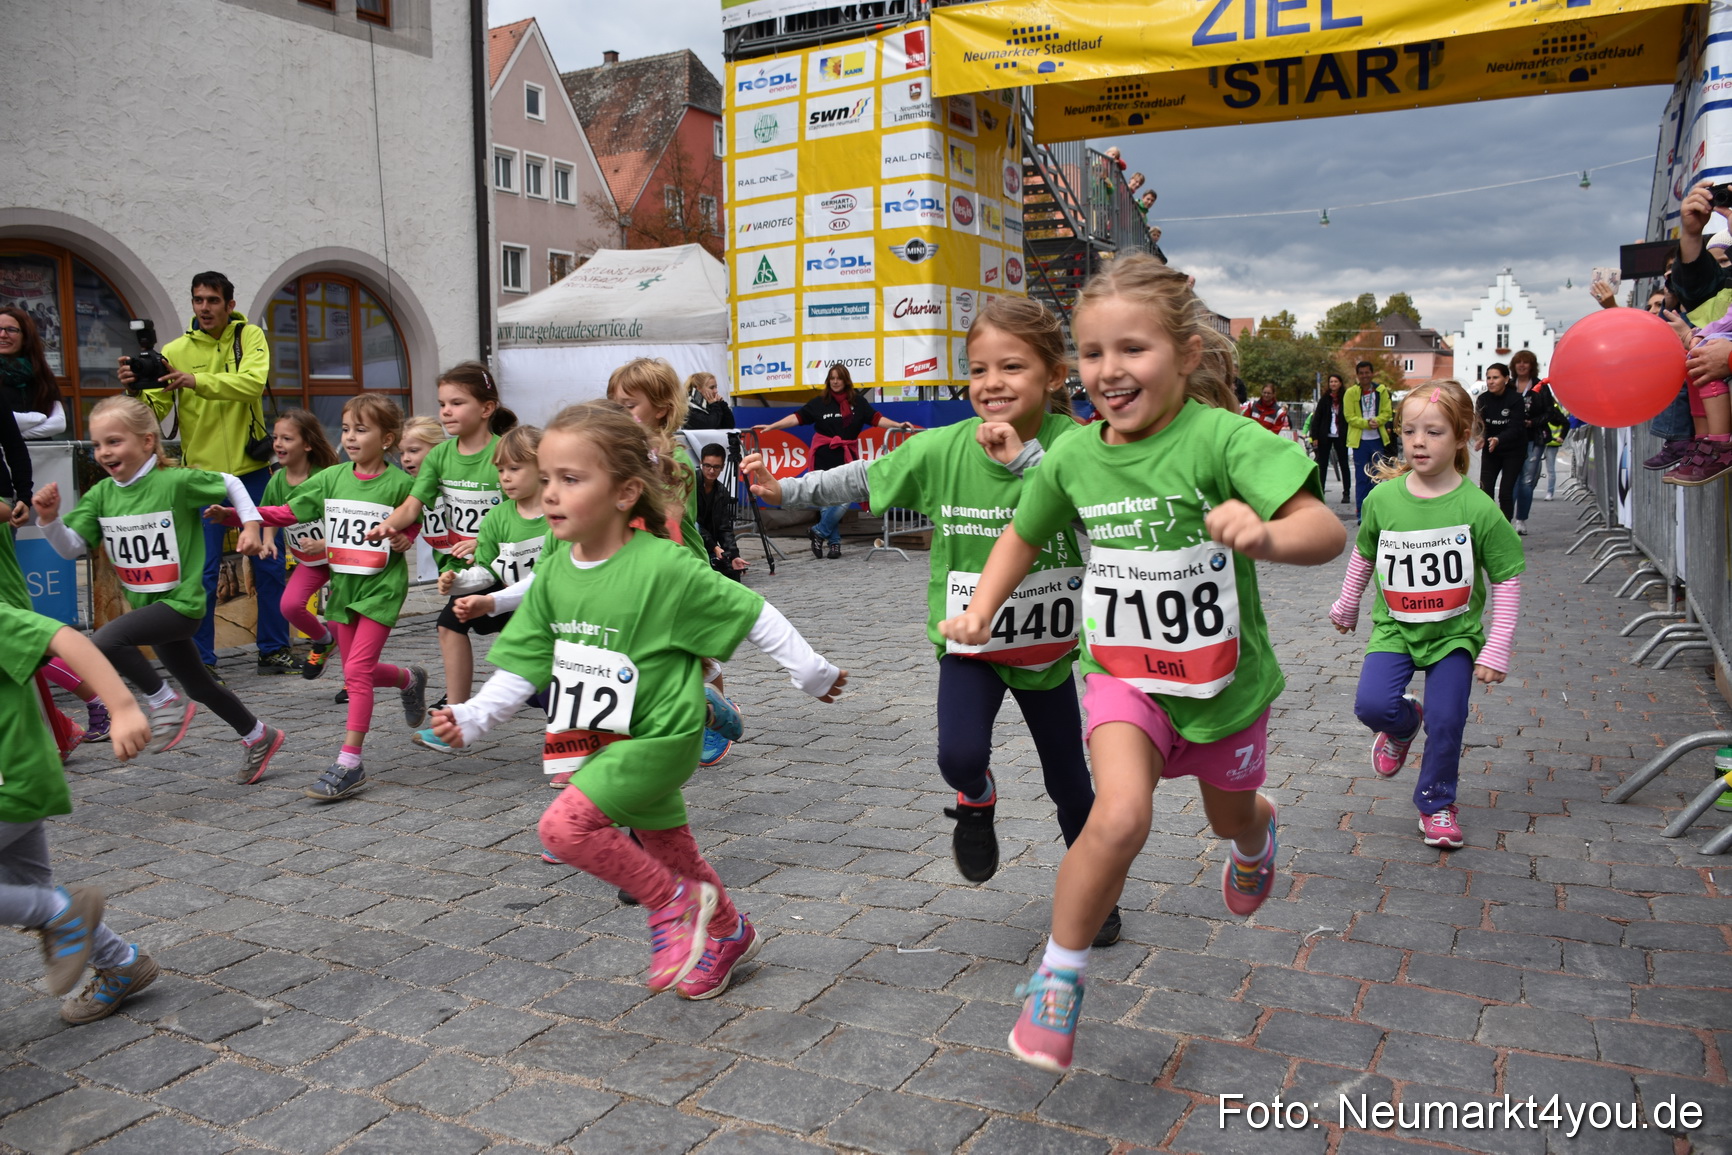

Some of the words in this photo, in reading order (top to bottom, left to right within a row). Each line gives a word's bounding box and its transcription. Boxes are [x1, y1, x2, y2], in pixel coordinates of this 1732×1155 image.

[1192, 0, 1363, 46] ZIEL
[963, 45, 1041, 63] Neumarkter
[1044, 35, 1103, 56] Stadtlauf
[1486, 54, 1571, 74] Neumarkter
[1574, 44, 1645, 63] Stadtlauf
[1223, 40, 1445, 109] START
[769, 83, 797, 94] energie
[1064, 100, 1131, 116] Neumarkter
[1132, 95, 1186, 110] Stadtlauf
[809, 106, 850, 125] swn
[753, 217, 794, 231] VARIOTEC
[833, 221, 846, 229] KIA
[907, 246, 925, 255] MINI
[840, 266, 872, 276] energie
[811, 307, 843, 316] Neumarkter
[843, 305, 867, 315] Tagblatt
[766, 370, 792, 381] energie
[454, 496, 488, 505] Neumarkt
[326, 506, 341, 514] PARTL
[342, 508, 379, 517] Neumarkt
[116, 522, 157, 532] Neumarkt
[105, 532, 170, 564] 7404
[1380, 540, 1400, 549] PARTL
[1402, 537, 1451, 549] Neumarkt
[125, 570, 153, 582] EVA
[1129, 562, 1205, 581] Neumarkt
[1384, 550, 1463, 587] 7130
[1401, 596, 1444, 610] Carina
[1095, 581, 1224, 644] 7198
[963, 598, 1074, 645] 440
[1144, 654, 1186, 678] Leni
[1235, 744, 1254, 770] 7
